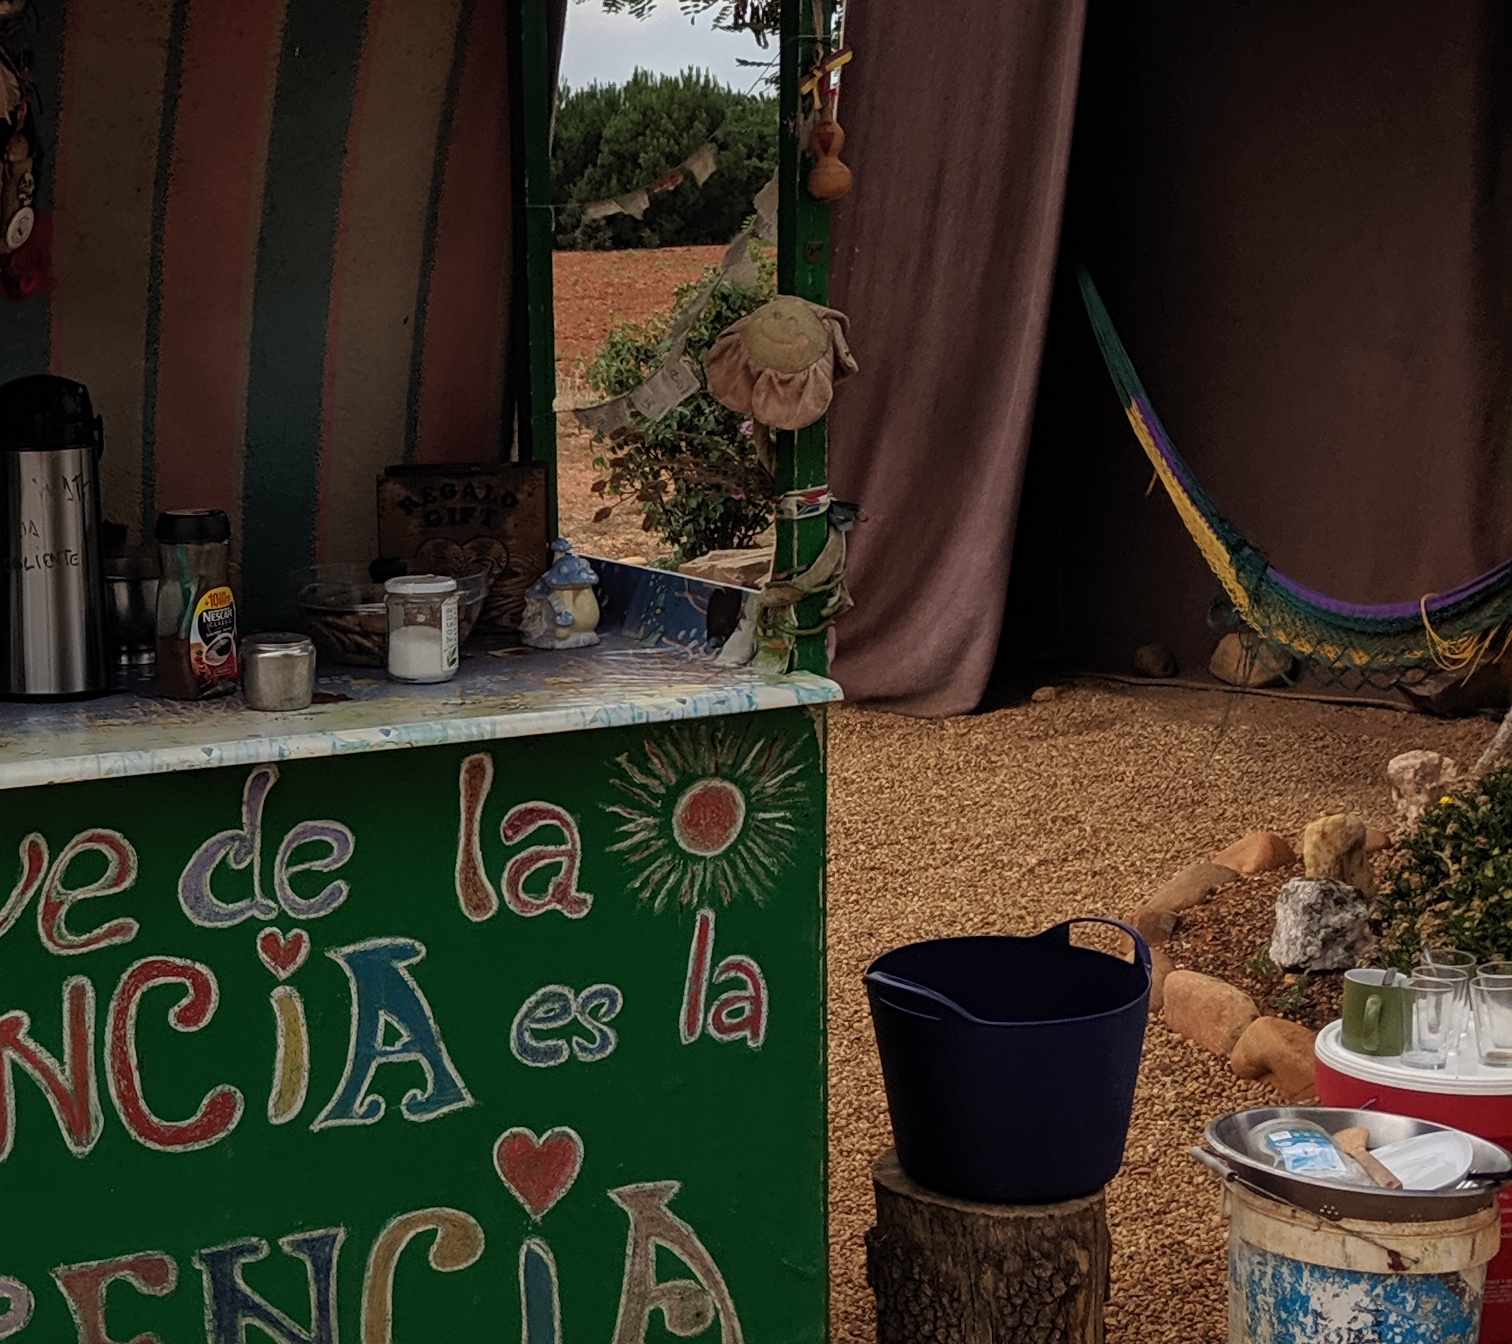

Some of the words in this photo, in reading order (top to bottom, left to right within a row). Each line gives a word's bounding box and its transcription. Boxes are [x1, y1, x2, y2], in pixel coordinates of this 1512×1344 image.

[398, 481, 518, 517] REGALO
[424, 506, 498, 528] GIFT
[178, 764, 356, 929] de
[454, 751, 595, 923] la
[510, 983, 624, 1068] es
[679, 907, 770, 1050] la
